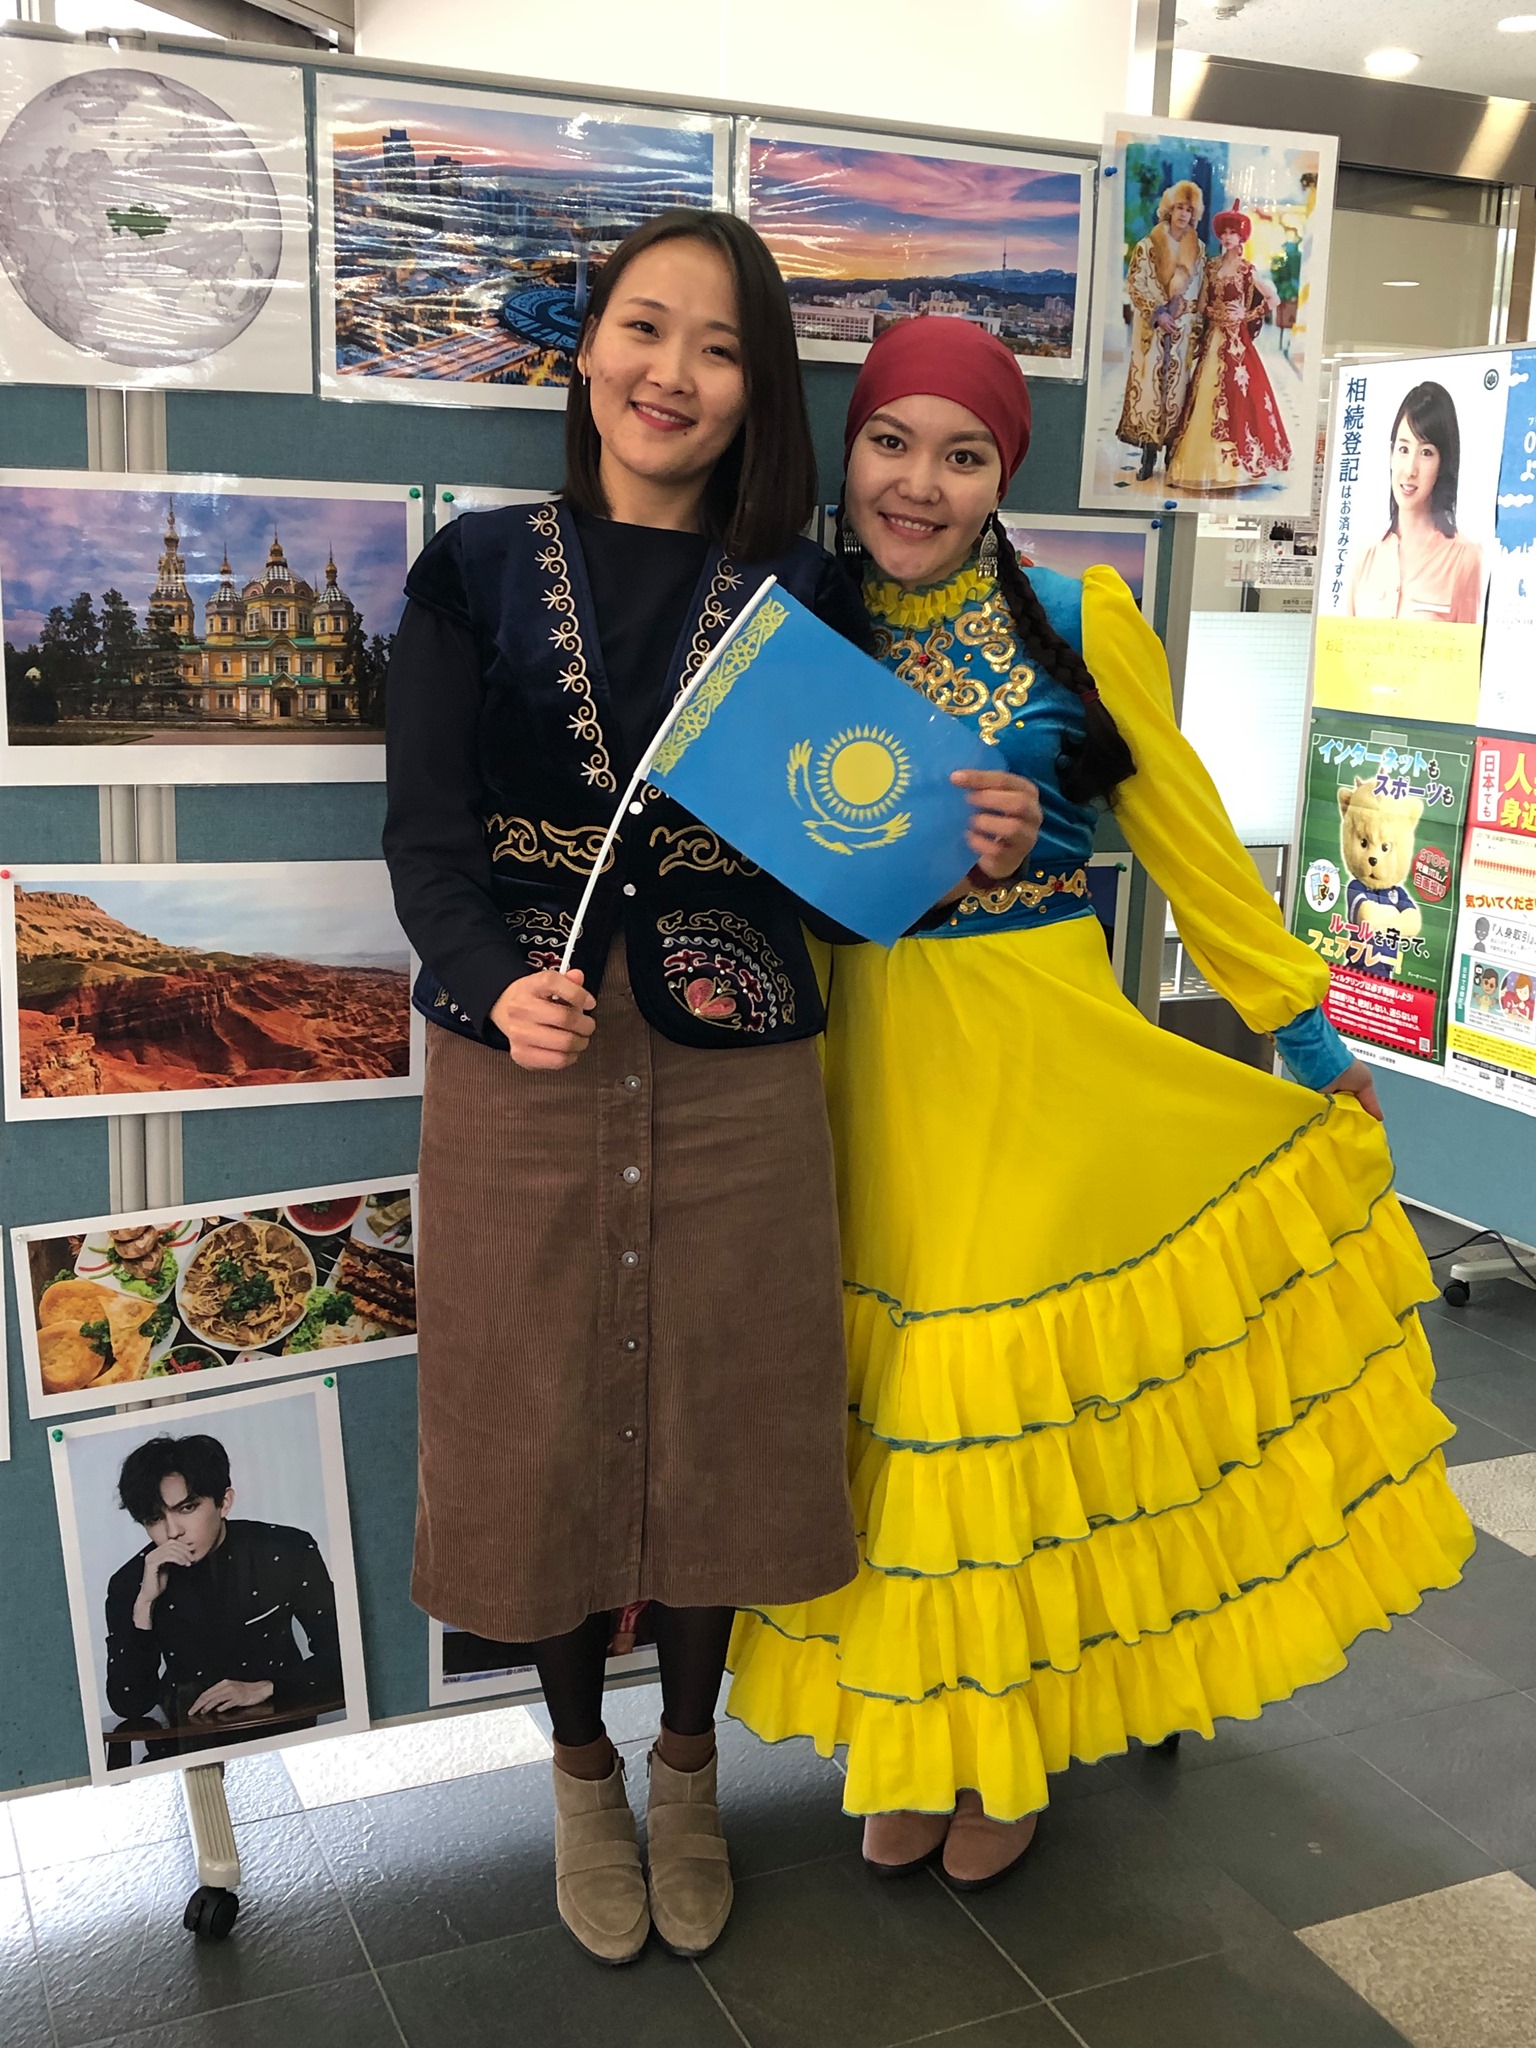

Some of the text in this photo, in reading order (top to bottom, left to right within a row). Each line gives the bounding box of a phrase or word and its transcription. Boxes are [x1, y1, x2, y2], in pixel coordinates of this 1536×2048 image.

[1332, 376, 1367, 608] 相続登記はお済みですか?
[1318, 738, 1440, 780] インターネットも
[1373, 774, 1454, 808] スポーツも
